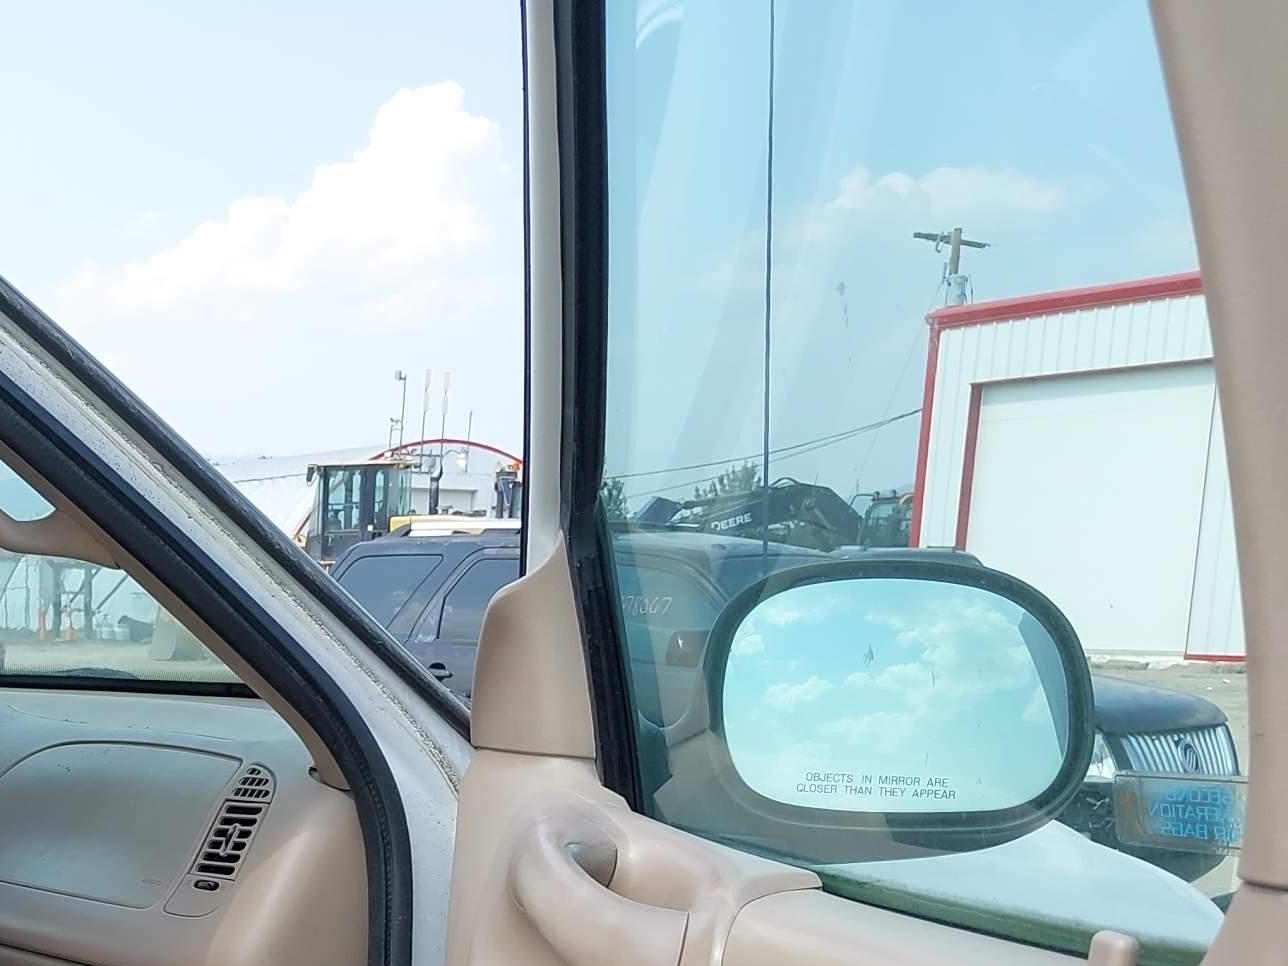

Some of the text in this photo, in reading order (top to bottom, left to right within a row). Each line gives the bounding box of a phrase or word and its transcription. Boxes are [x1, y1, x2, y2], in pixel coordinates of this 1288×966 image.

[711, 513, 752, 531] DEERE
[805, 772, 950, 788] OBJECTS IN MIRROR ARE
[796, 783, 956, 800] CLOSER THAN THEY APPEAR
